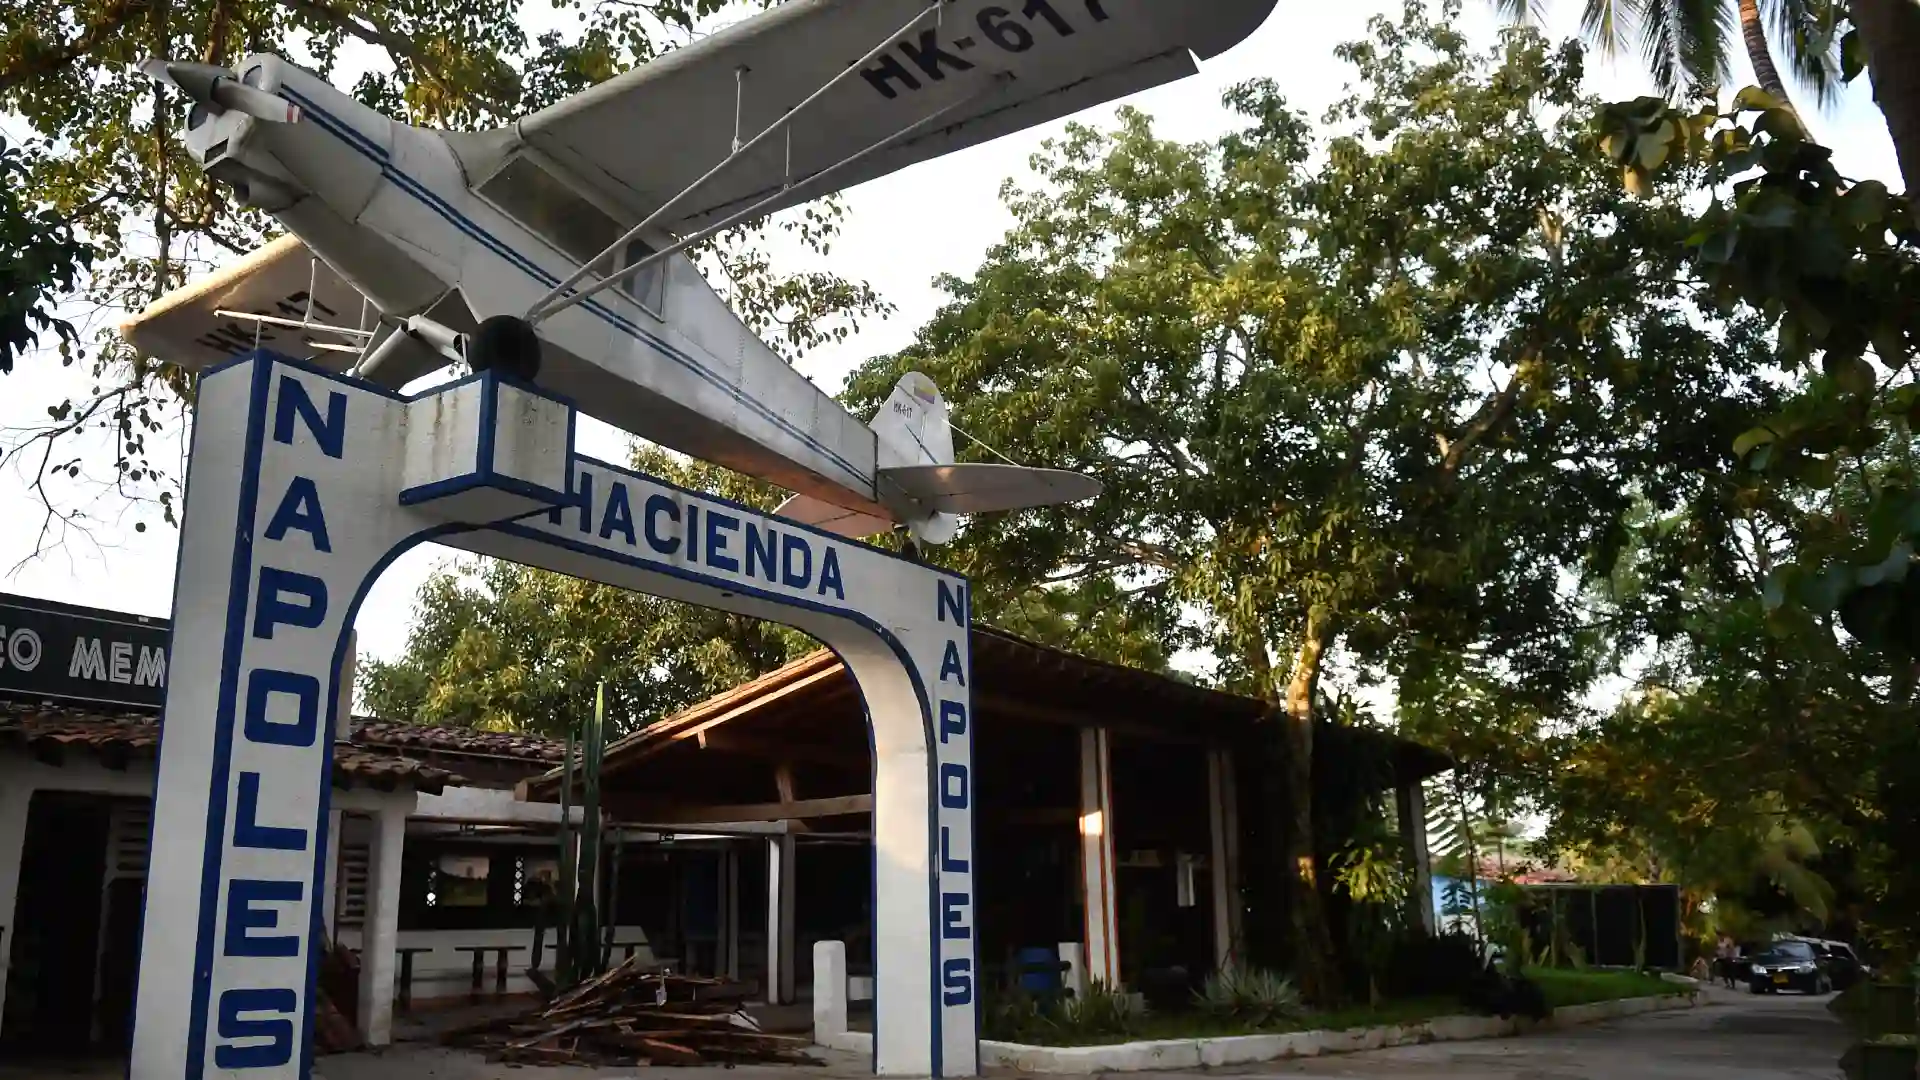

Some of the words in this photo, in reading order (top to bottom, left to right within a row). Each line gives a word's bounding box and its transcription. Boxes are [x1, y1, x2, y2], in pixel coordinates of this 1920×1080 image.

[214, 374, 347, 1069] NAPOLES
[549, 471, 846, 601] HACIENDA
[937, 578, 972, 1008] NAPOLES
